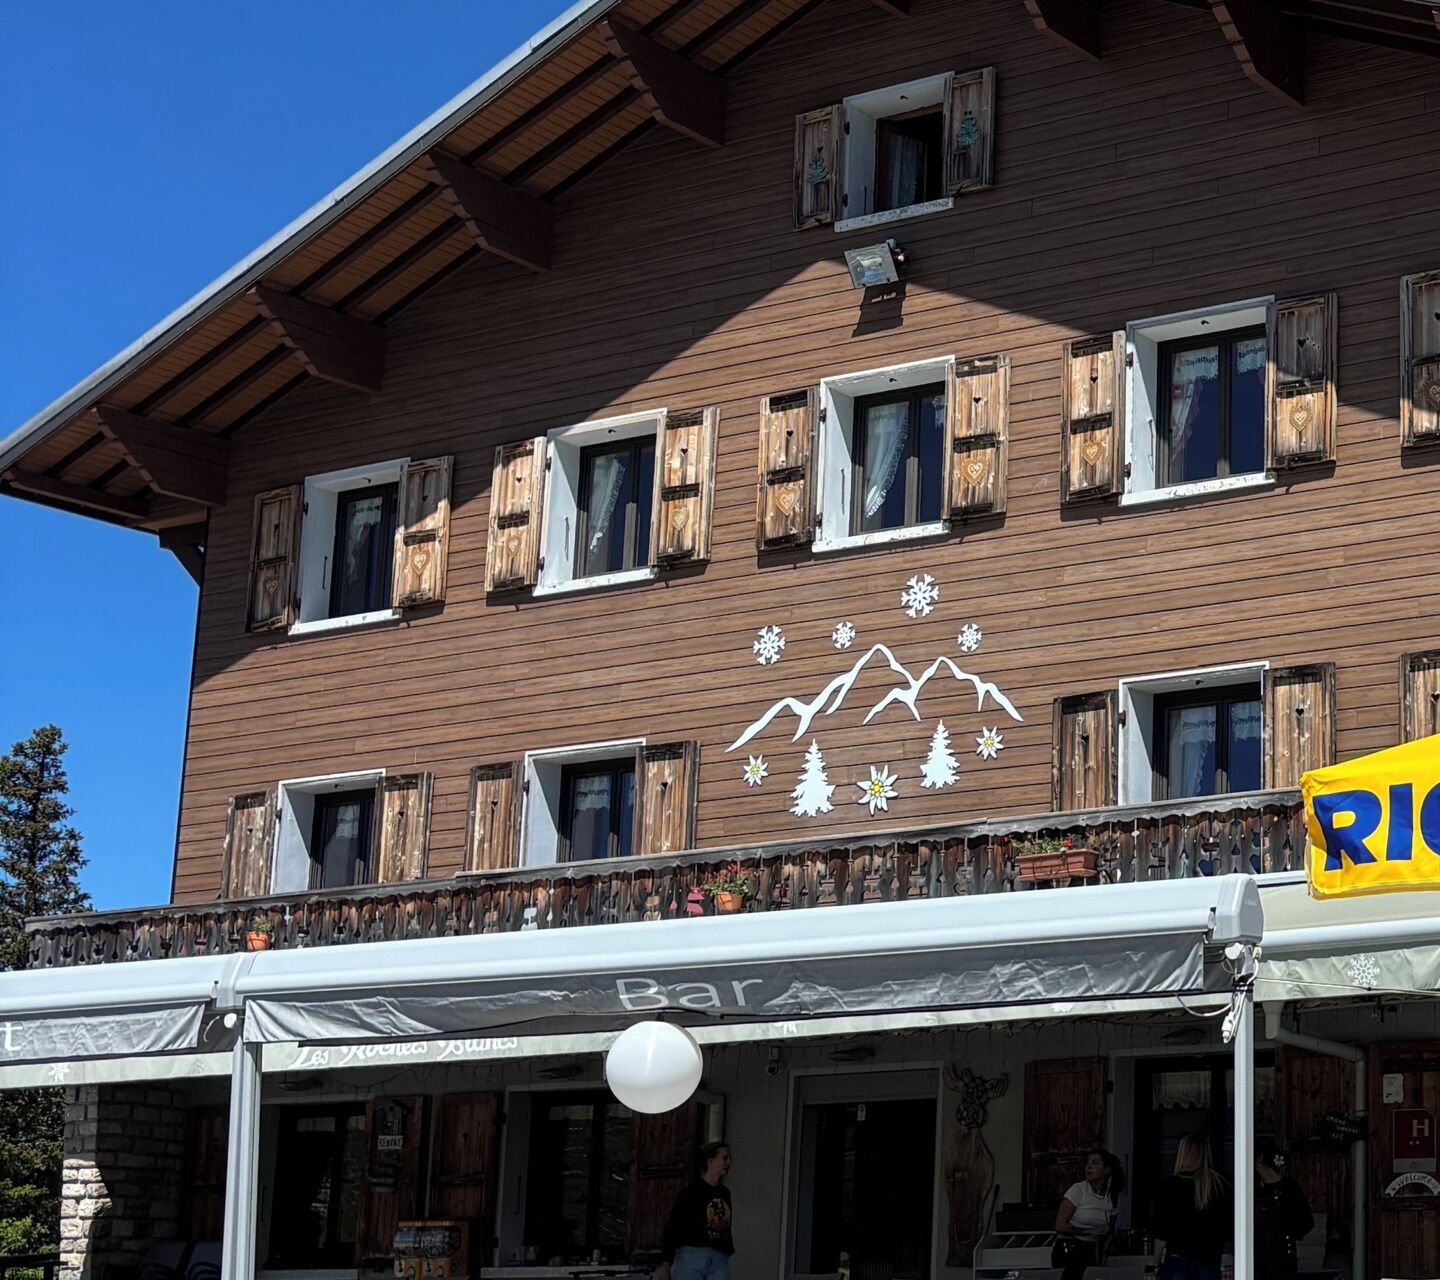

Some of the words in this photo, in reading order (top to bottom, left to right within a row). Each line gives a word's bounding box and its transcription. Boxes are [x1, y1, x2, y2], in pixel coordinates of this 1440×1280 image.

[616, 978, 762, 1010] Bar
[288, 1046, 329, 1070] Les
[1412, 1119, 1429, 1136] H
